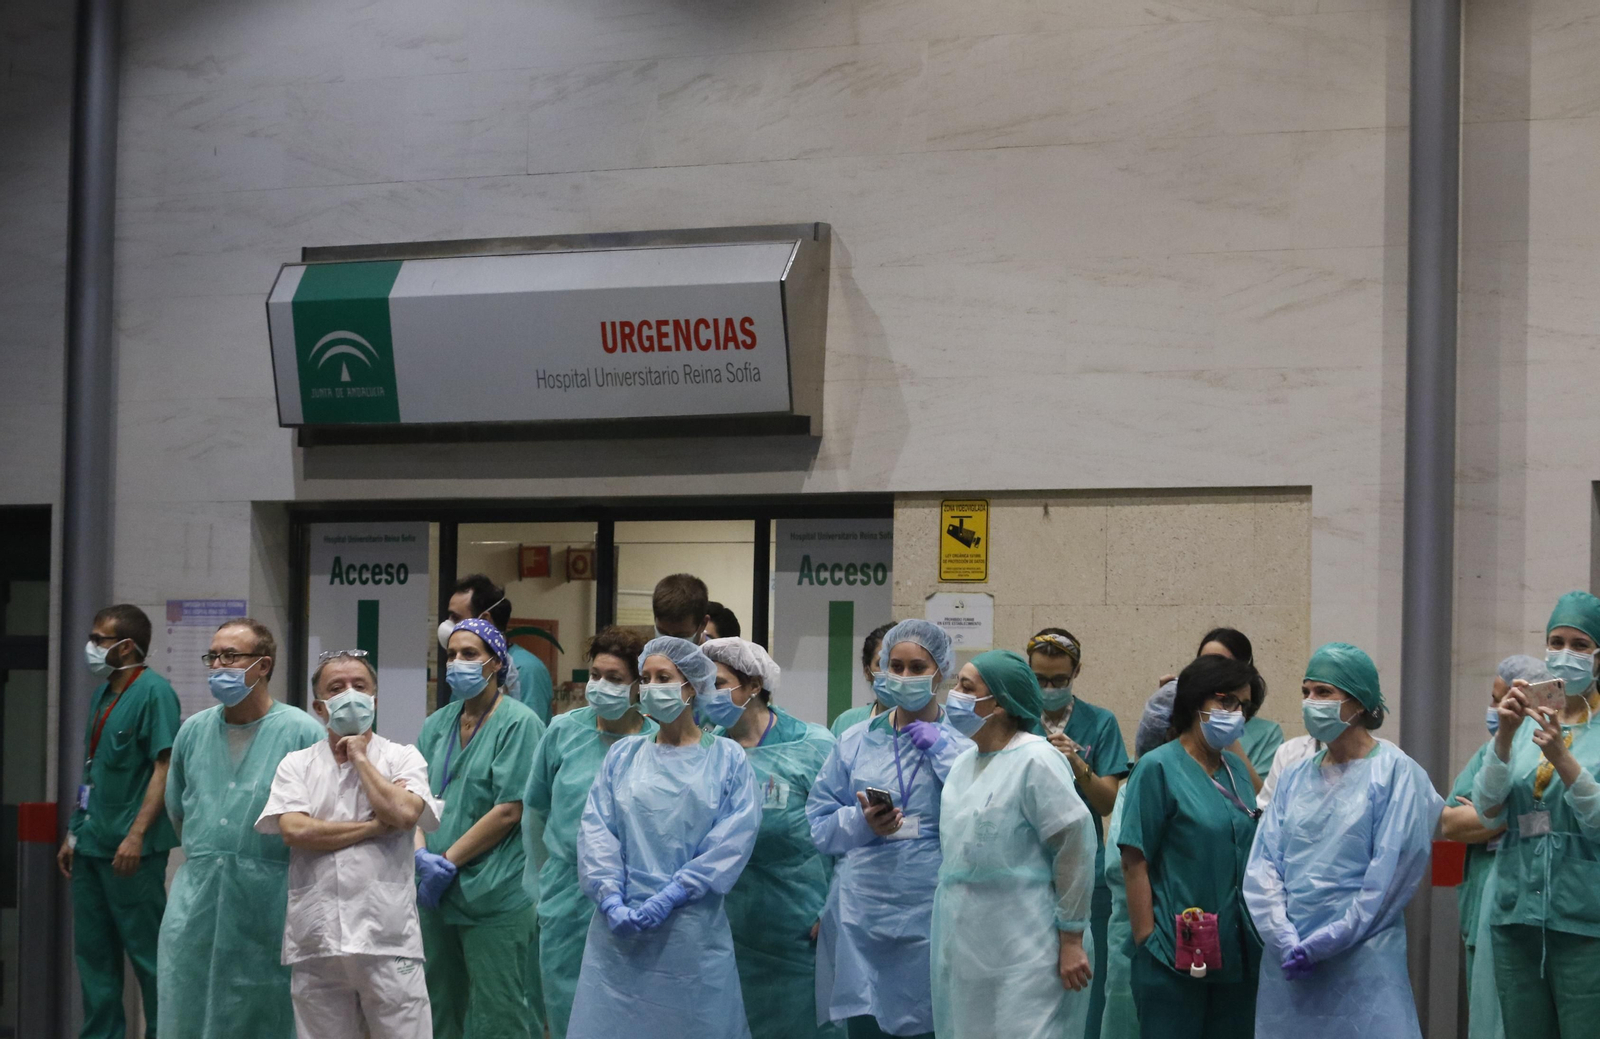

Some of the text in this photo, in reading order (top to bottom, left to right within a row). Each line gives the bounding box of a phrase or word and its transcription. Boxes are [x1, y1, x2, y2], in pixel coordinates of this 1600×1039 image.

[600, 316, 757, 354] URGENCIAS
[535, 362, 761, 392] Hospital Universitario Reina Sofía
[311, 388, 333, 398] JUNTA
[335, 388, 344, 398] DE
[944, 503, 986, 512] ZONA VIDEOVIGILADA
[790, 532, 816, 541] Hospital
[817, 531, 858, 540] Universitario
[859, 531, 878, 540] Reina
[329, 555, 409, 585] Acceso
[797, 554, 888, 586] Acceso
